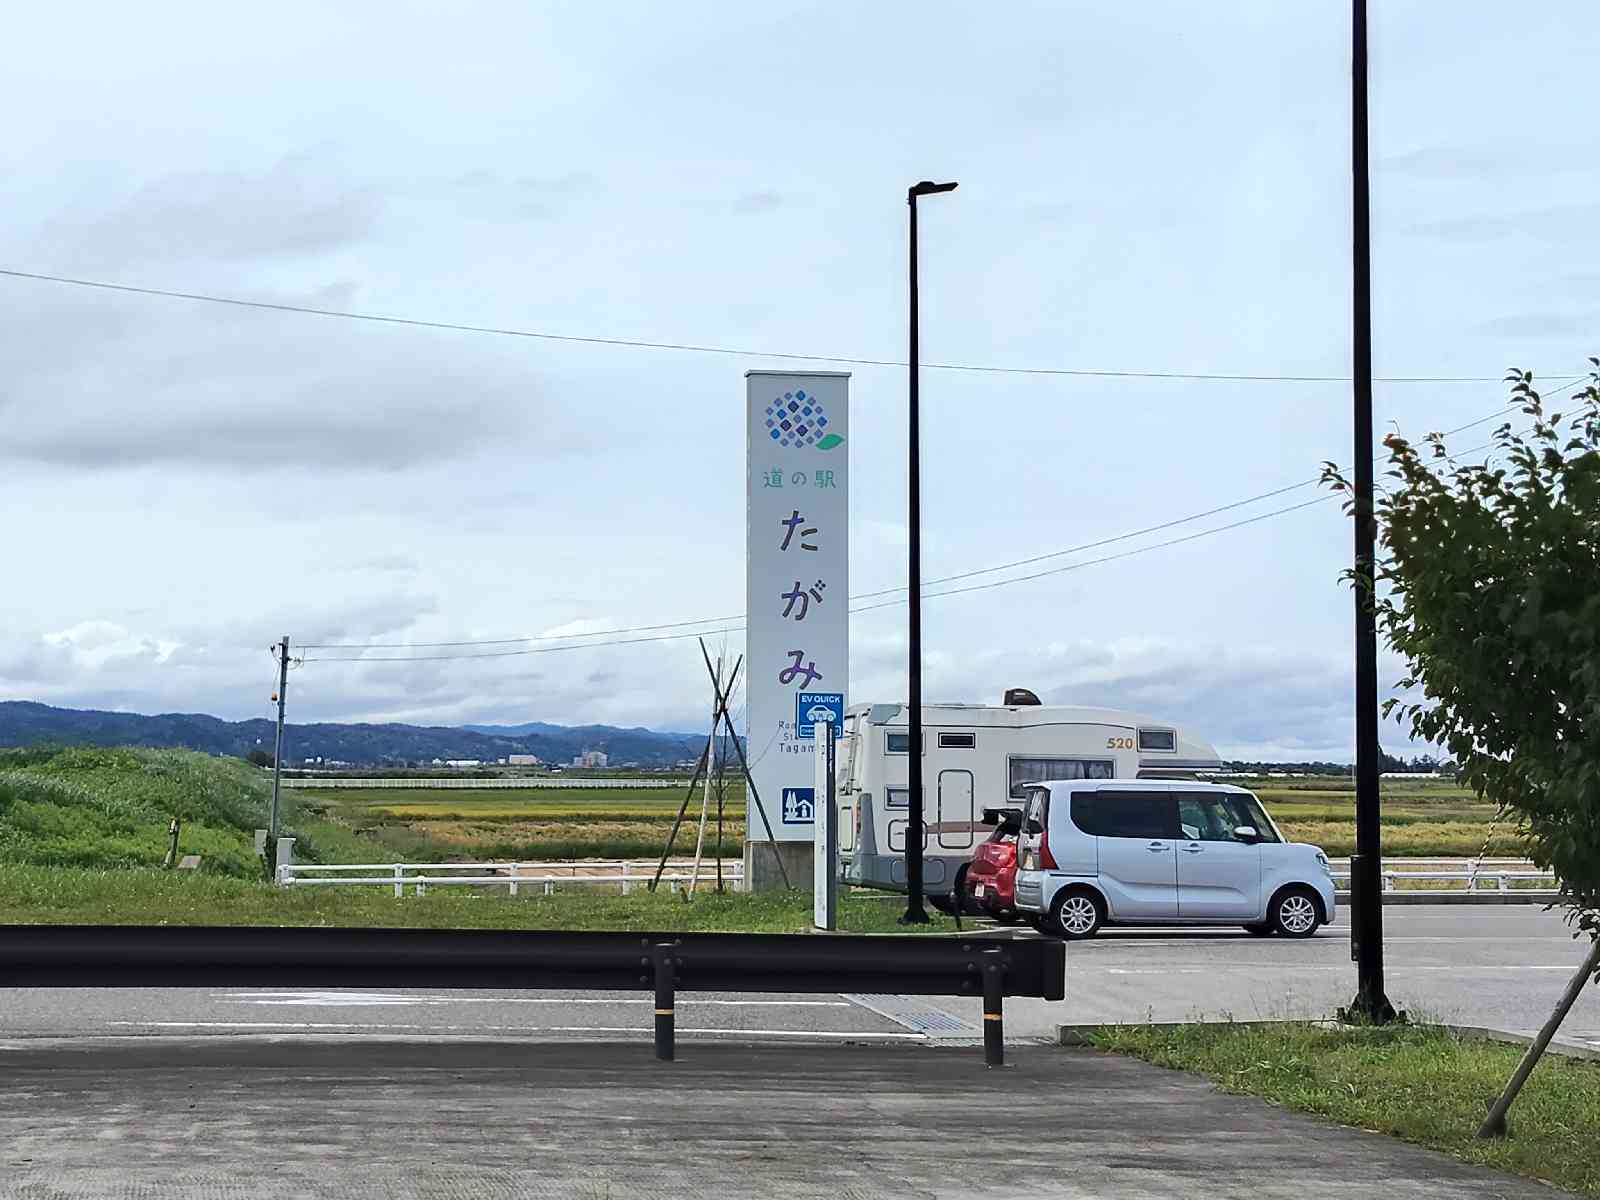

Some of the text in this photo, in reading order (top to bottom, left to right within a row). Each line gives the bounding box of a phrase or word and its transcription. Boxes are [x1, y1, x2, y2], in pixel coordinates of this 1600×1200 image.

[763, 467, 836, 489] 道の駅
[778, 510, 826, 690] たがみ
[801, 695, 841, 703] EV QUICK
[1106, 737, 1134, 750] 520
